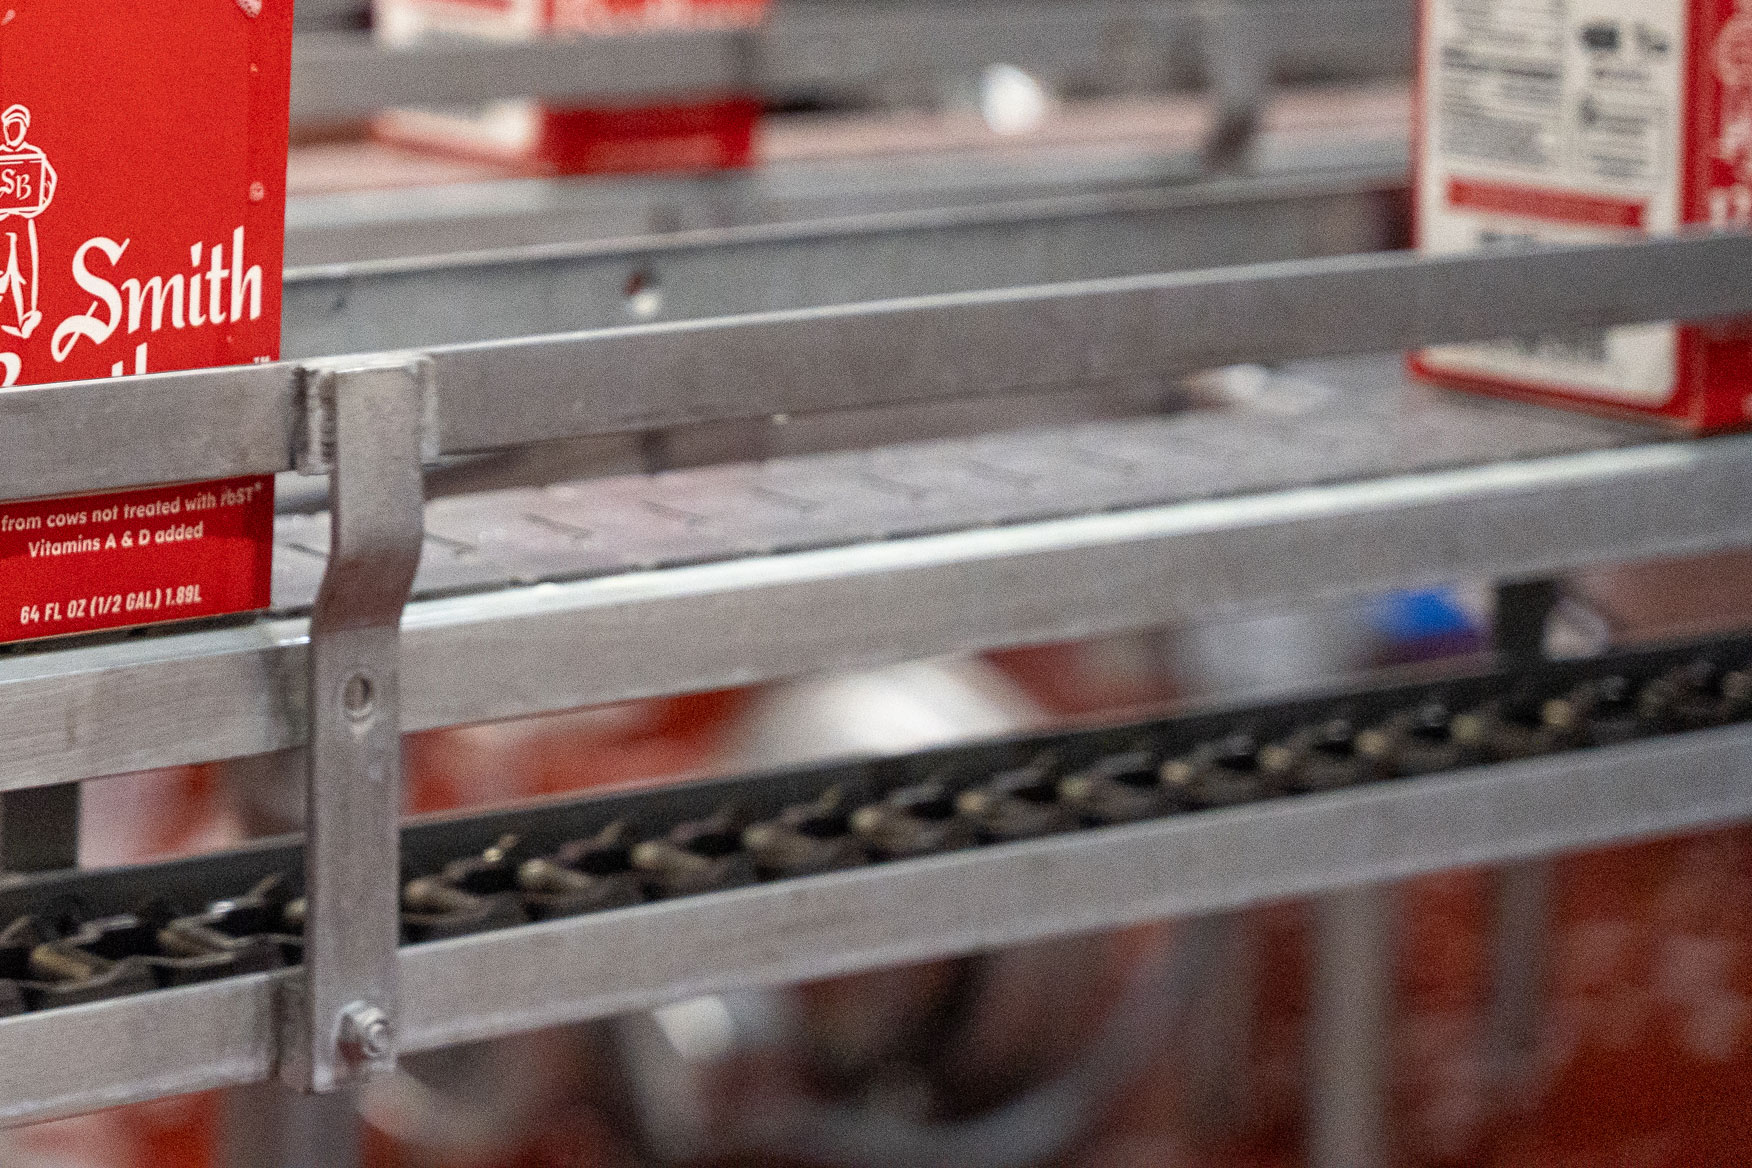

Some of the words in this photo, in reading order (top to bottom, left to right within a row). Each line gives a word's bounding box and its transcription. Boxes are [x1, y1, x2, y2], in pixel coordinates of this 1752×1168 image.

[51, 225, 263, 362] Smith
[1, 515, 42, 532] from
[46, 511, 87, 528] cows
[92, 505, 119, 523] not
[124, 496, 181, 519] treated
[185, 491, 217, 511] with
[28, 534, 101, 558] Vitamins
[104, 533, 117, 549] A
[121, 530, 134, 548] &
[138, 529, 151, 546] D
[154, 520, 204, 544] added
[20, 605, 40, 625] 64
[44, 602, 62, 623] FL
[67, 599, 86, 619] OZ
[90, 594, 122, 617] (1/2
[125, 588, 162, 612] GAL)
[165, 584, 202, 606] 1.89L
